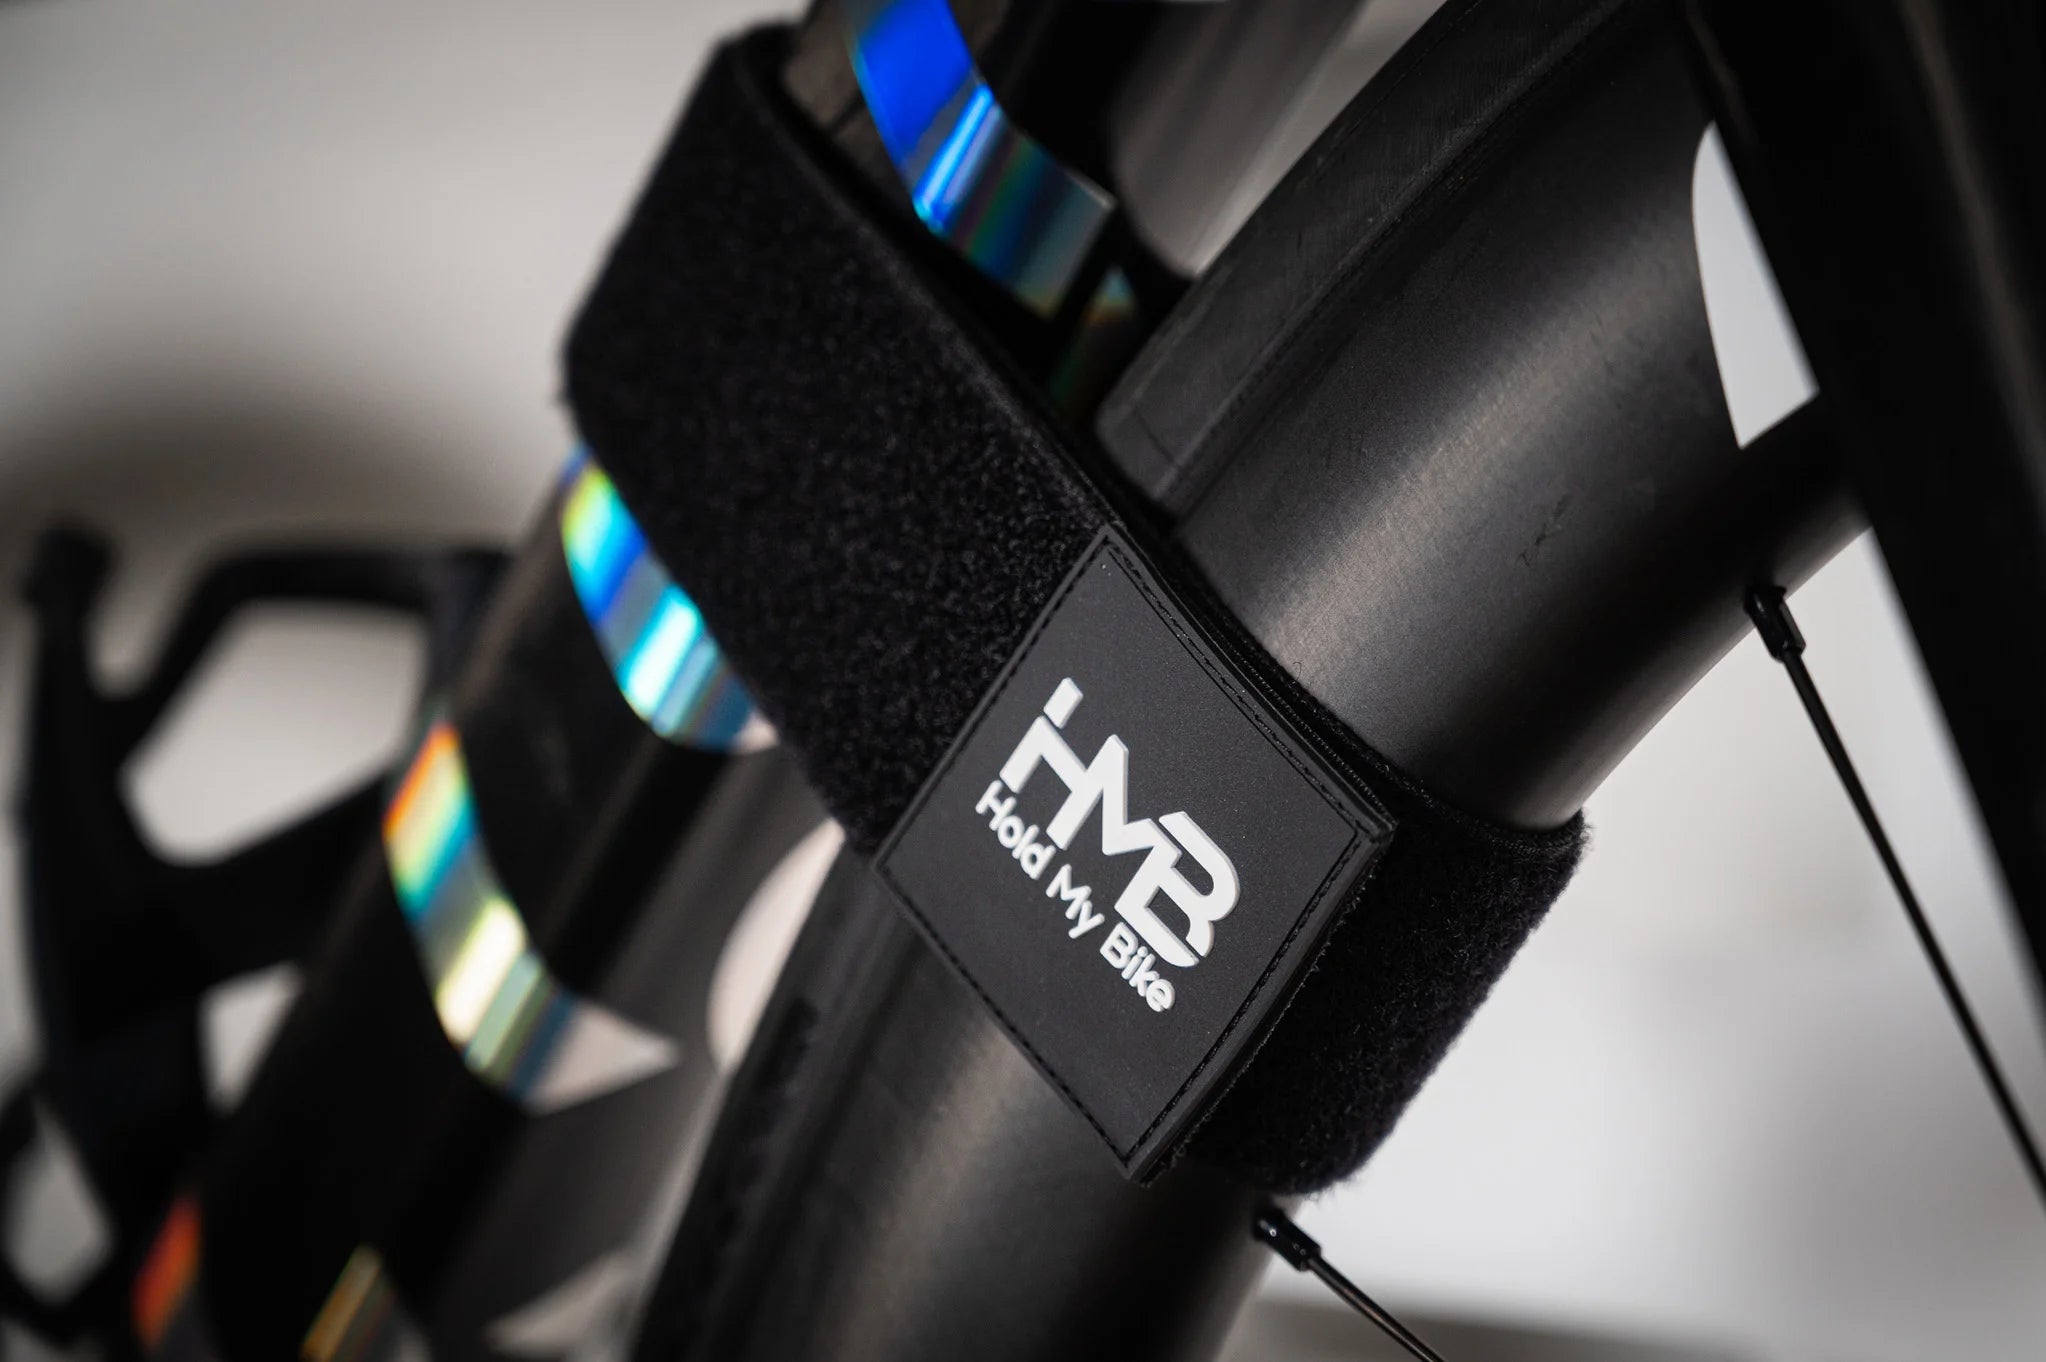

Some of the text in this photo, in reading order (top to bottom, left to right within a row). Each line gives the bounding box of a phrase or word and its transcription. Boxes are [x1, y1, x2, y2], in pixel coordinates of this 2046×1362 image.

[975, 779, 1176, 1013] Hold My Bike
[999, 677, 1241, 968] HMB
